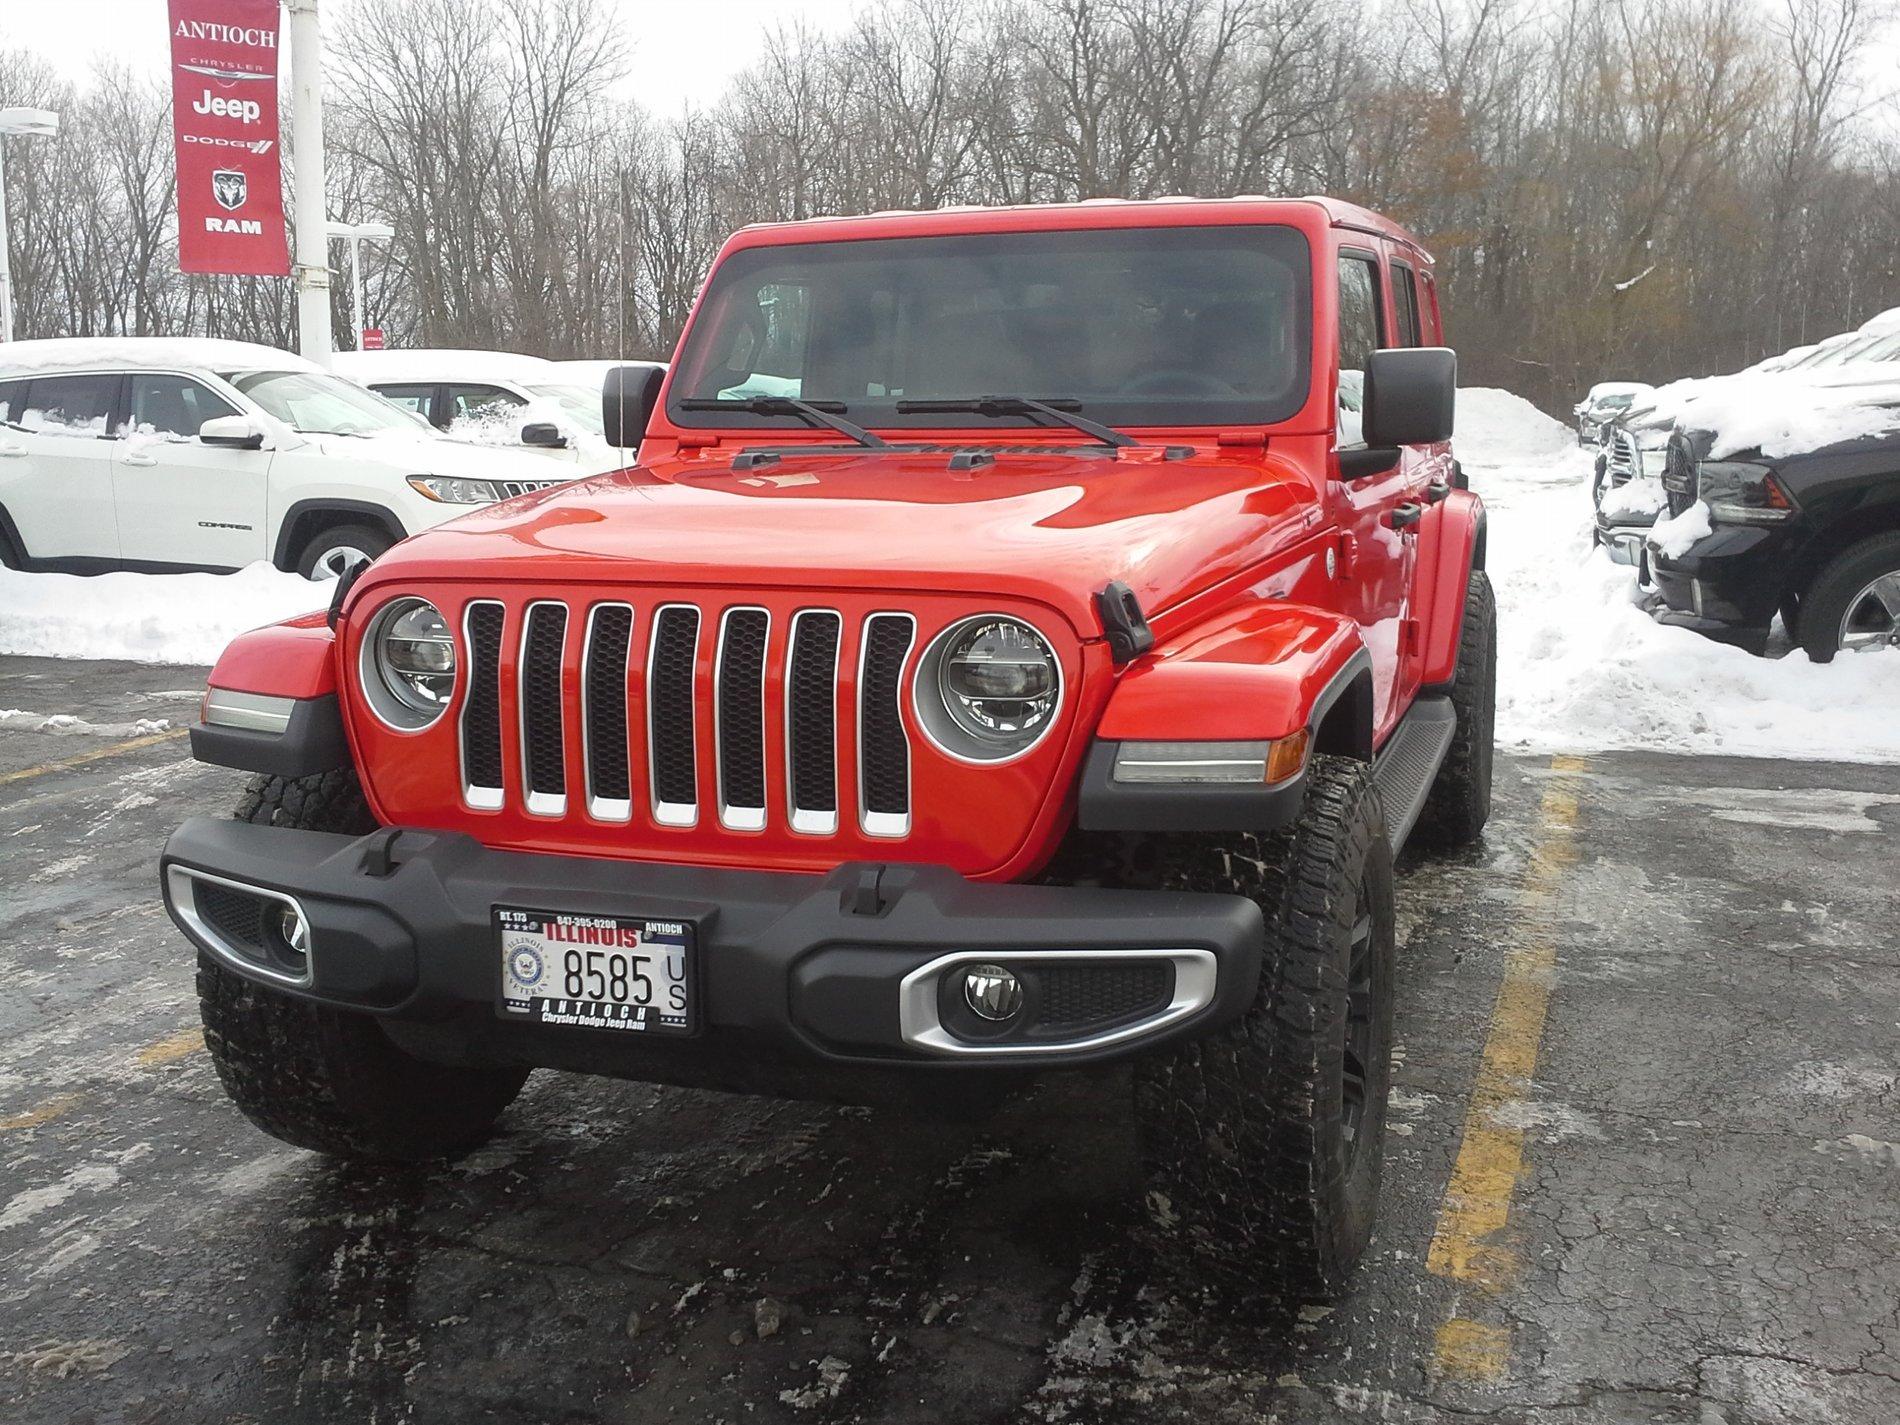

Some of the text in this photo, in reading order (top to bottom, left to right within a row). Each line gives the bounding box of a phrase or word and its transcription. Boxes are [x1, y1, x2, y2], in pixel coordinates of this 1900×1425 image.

[175, 19, 276, 48] ANTIOCH
[190, 57, 263, 72] CHRYSLER
[193, 89, 261, 123] Jeep
[183, 135, 258, 149] DODGE
[205, 217, 262, 235] RAM
[198, 521, 252, 530] COMPASS
[513, 912, 527, 922] 173
[556, 916, 617, 930] 847-395-0200
[546, 923, 638, 948] ILLINOIS
[645, 922, 683, 934] ANTIOCH
[564, 949, 653, 1005] 8585
[541, 1012, 646, 1031] Chrysler Dodge Jeep Ram
